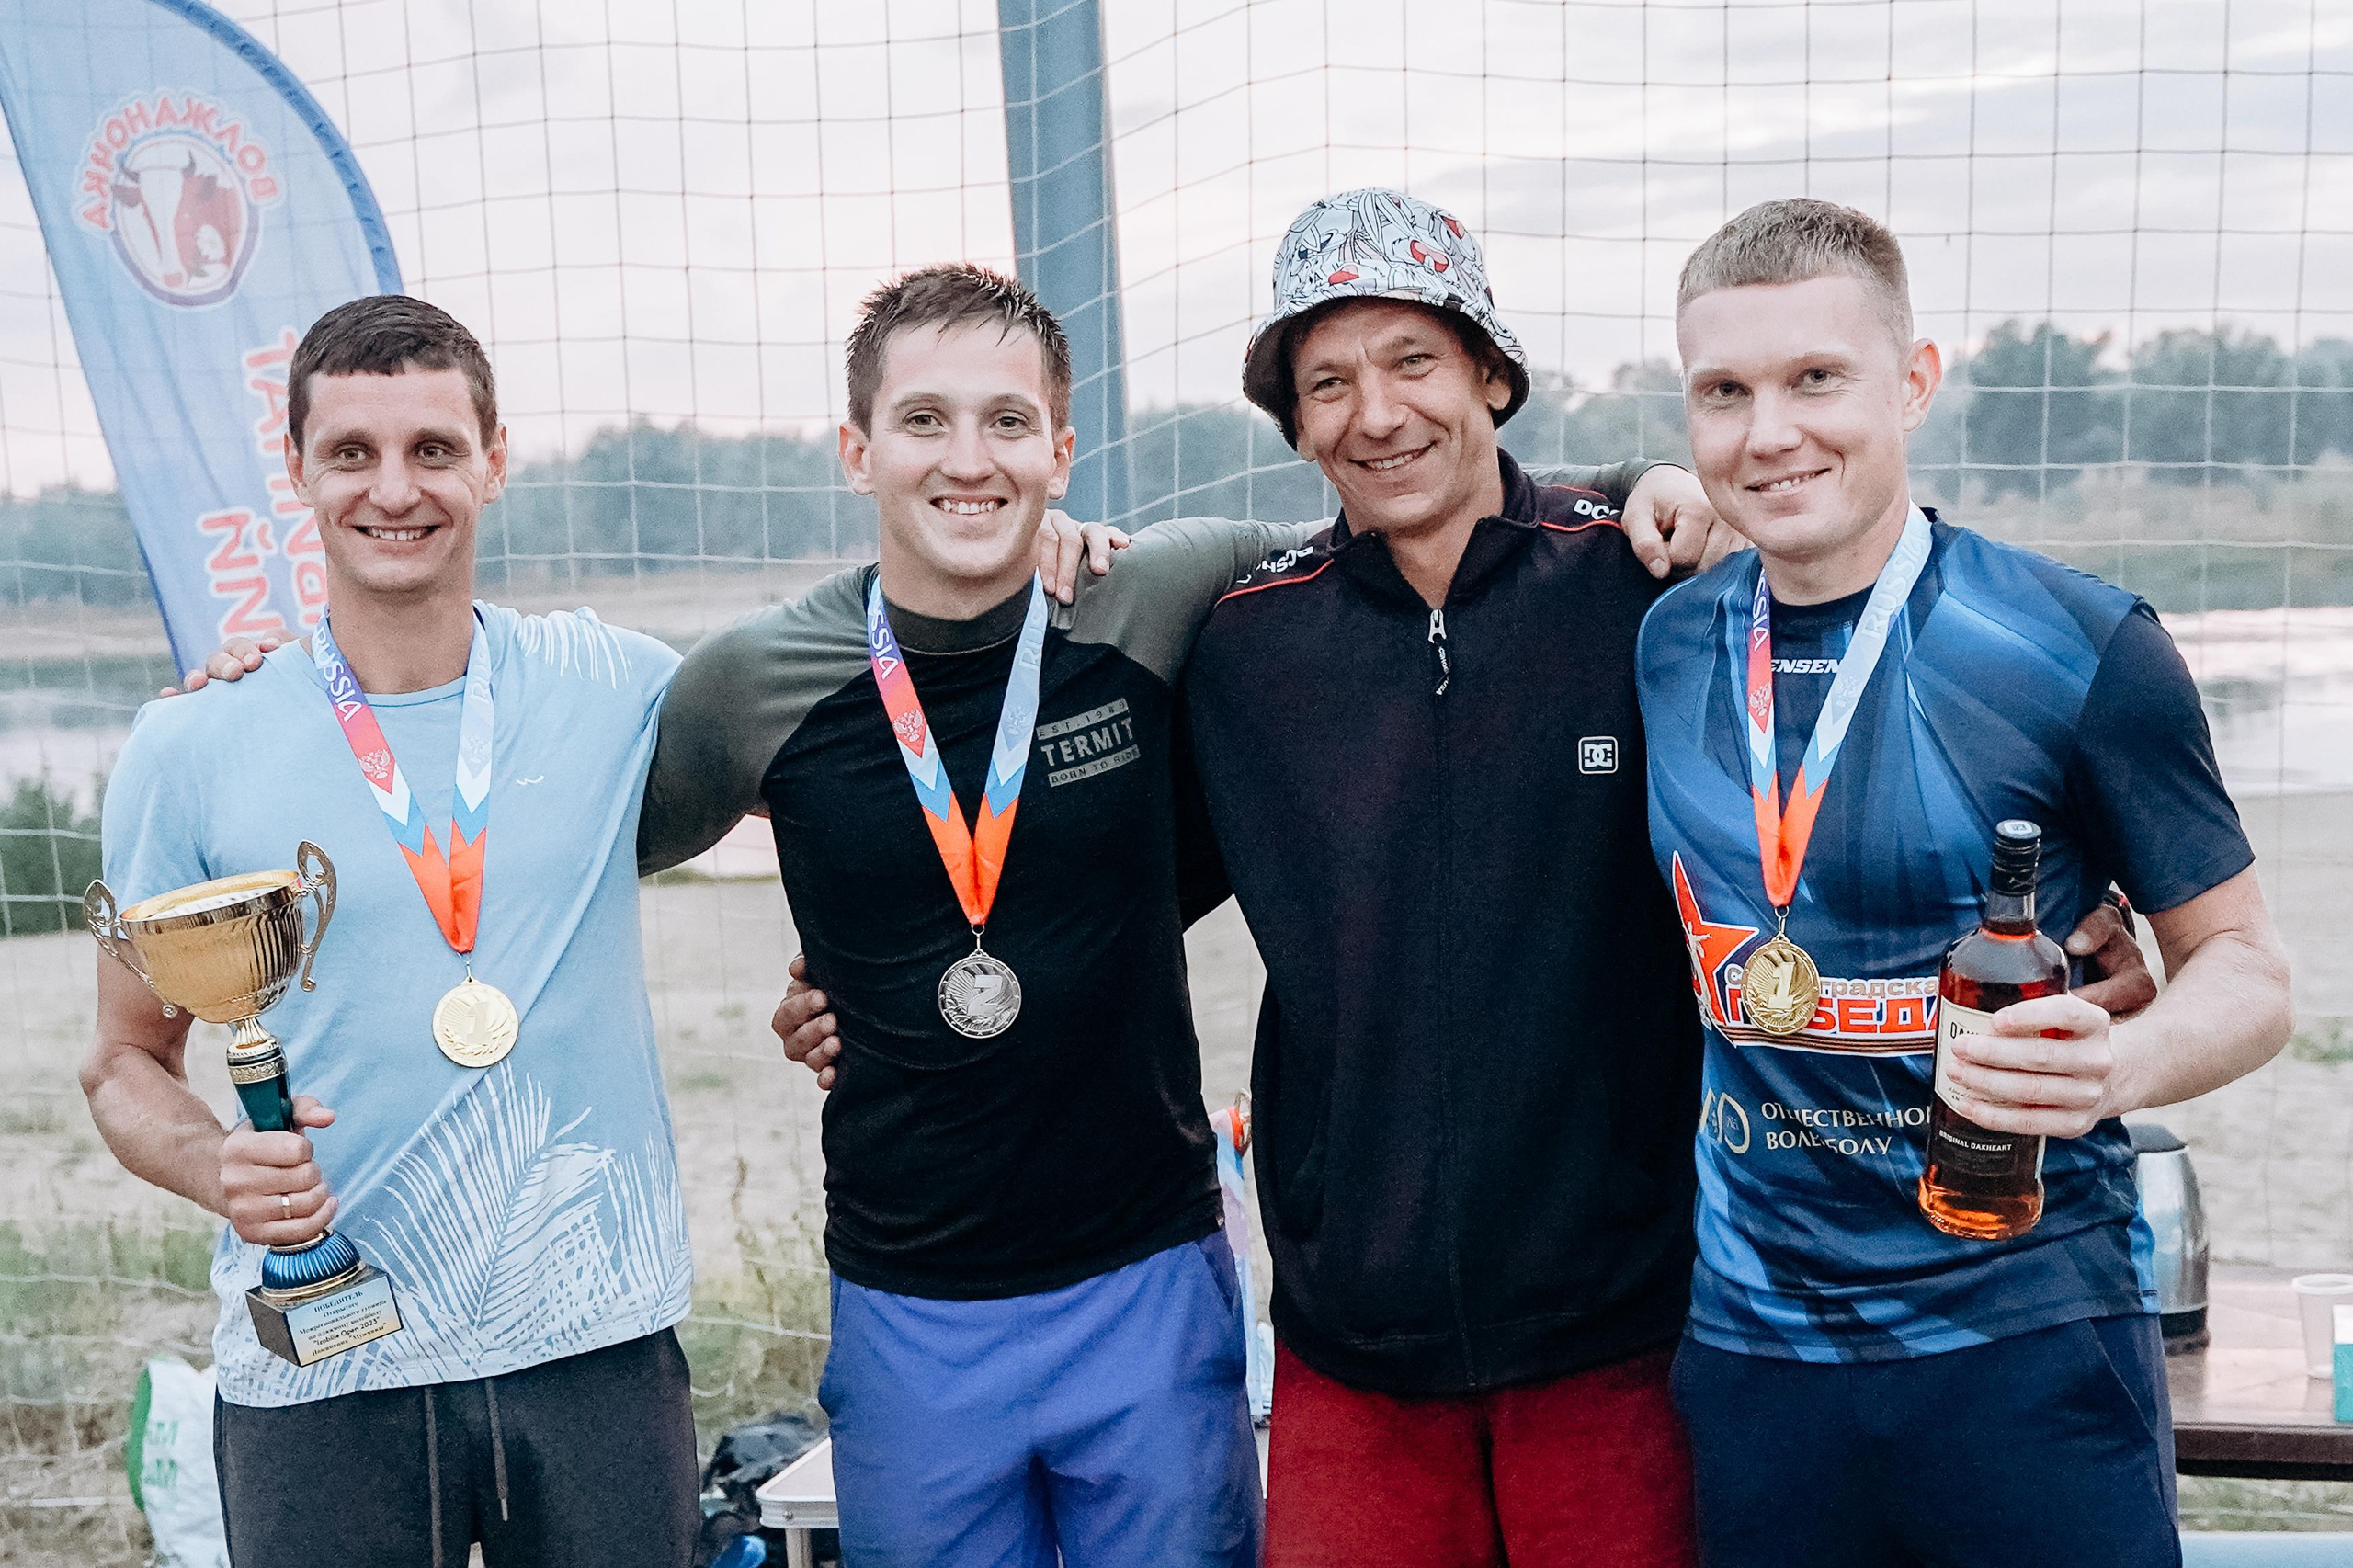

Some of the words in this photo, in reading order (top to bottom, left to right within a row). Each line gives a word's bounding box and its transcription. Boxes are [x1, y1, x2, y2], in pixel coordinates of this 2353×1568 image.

[1862, 535, 1927, 639] RUSSIA
[1040, 717, 1133, 767] TERMIT
[1051, 767, 1087, 785] BORN
[1093, 760, 1108, 772] TO
[967, 974, 1003, 1017] 2
[1768, 961, 1796, 1009] 1
[1970, 1142, 2012, 1152] OAKHEART
